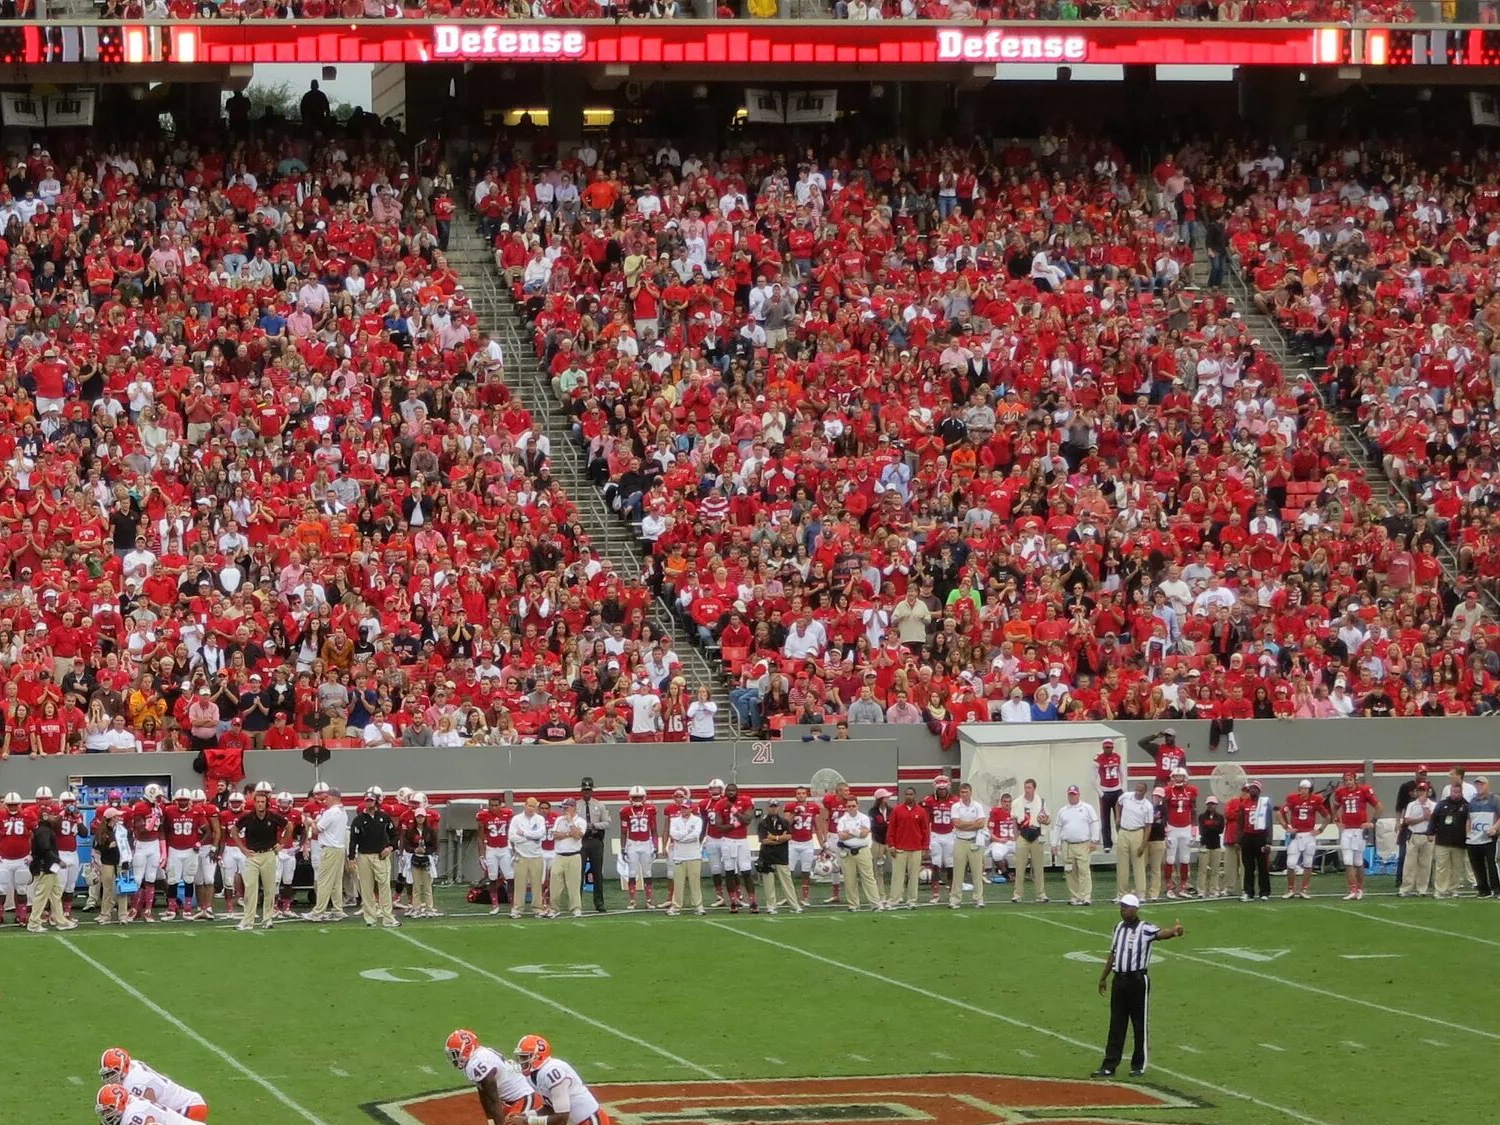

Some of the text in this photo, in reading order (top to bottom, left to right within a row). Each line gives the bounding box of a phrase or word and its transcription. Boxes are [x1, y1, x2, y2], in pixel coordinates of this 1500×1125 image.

[434, 26, 585, 58] Defense
[937, 29, 1087, 60] Defense
[752, 742, 774, 764] 21
[1345, 799, 1357, 813] 11
[793, 816, 812, 830] 34
[933, 810, 950, 824] 26
[3, 821, 23, 836] 76
[172, 822, 192, 836] 98
[488, 824, 507, 837] 34
[630, 818, 648, 832] 29
[472, 1062, 488, 1079] 45
[546, 1068, 562, 1084] 10
